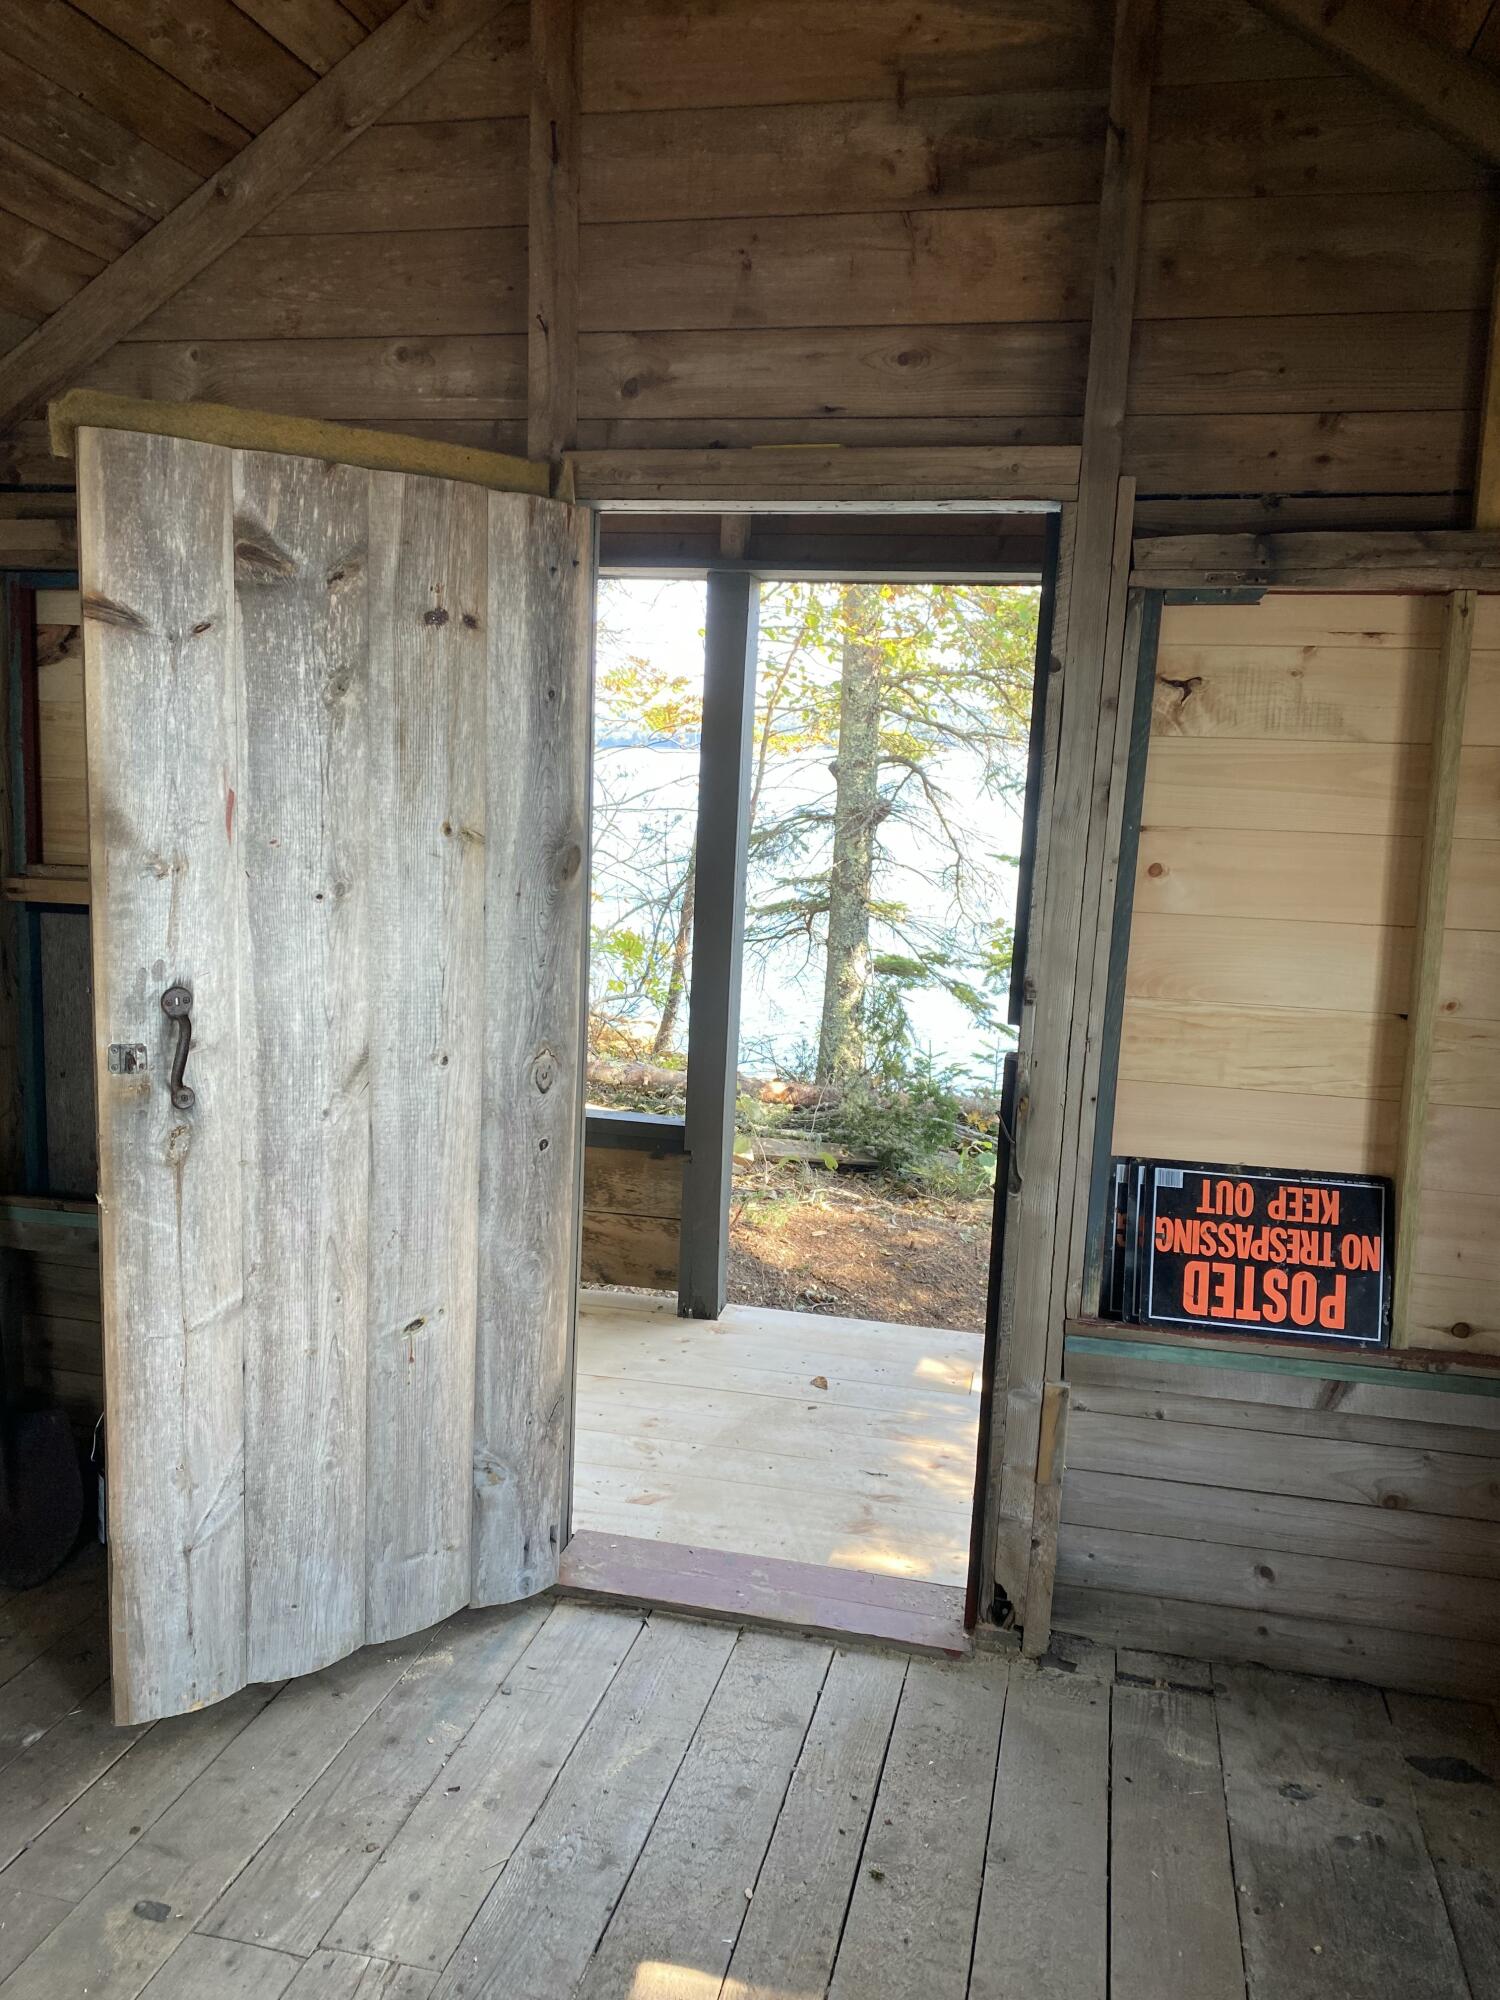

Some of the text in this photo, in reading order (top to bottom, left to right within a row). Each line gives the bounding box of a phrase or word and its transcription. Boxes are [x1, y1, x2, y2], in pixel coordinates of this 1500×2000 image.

[1197, 1180, 1340, 1226] KEEP OUT
[1156, 1217, 1335, 1267] TRESPASSING
[1341, 1234, 1381, 1271] NO
[1183, 1261, 1346, 1328] POSTED
